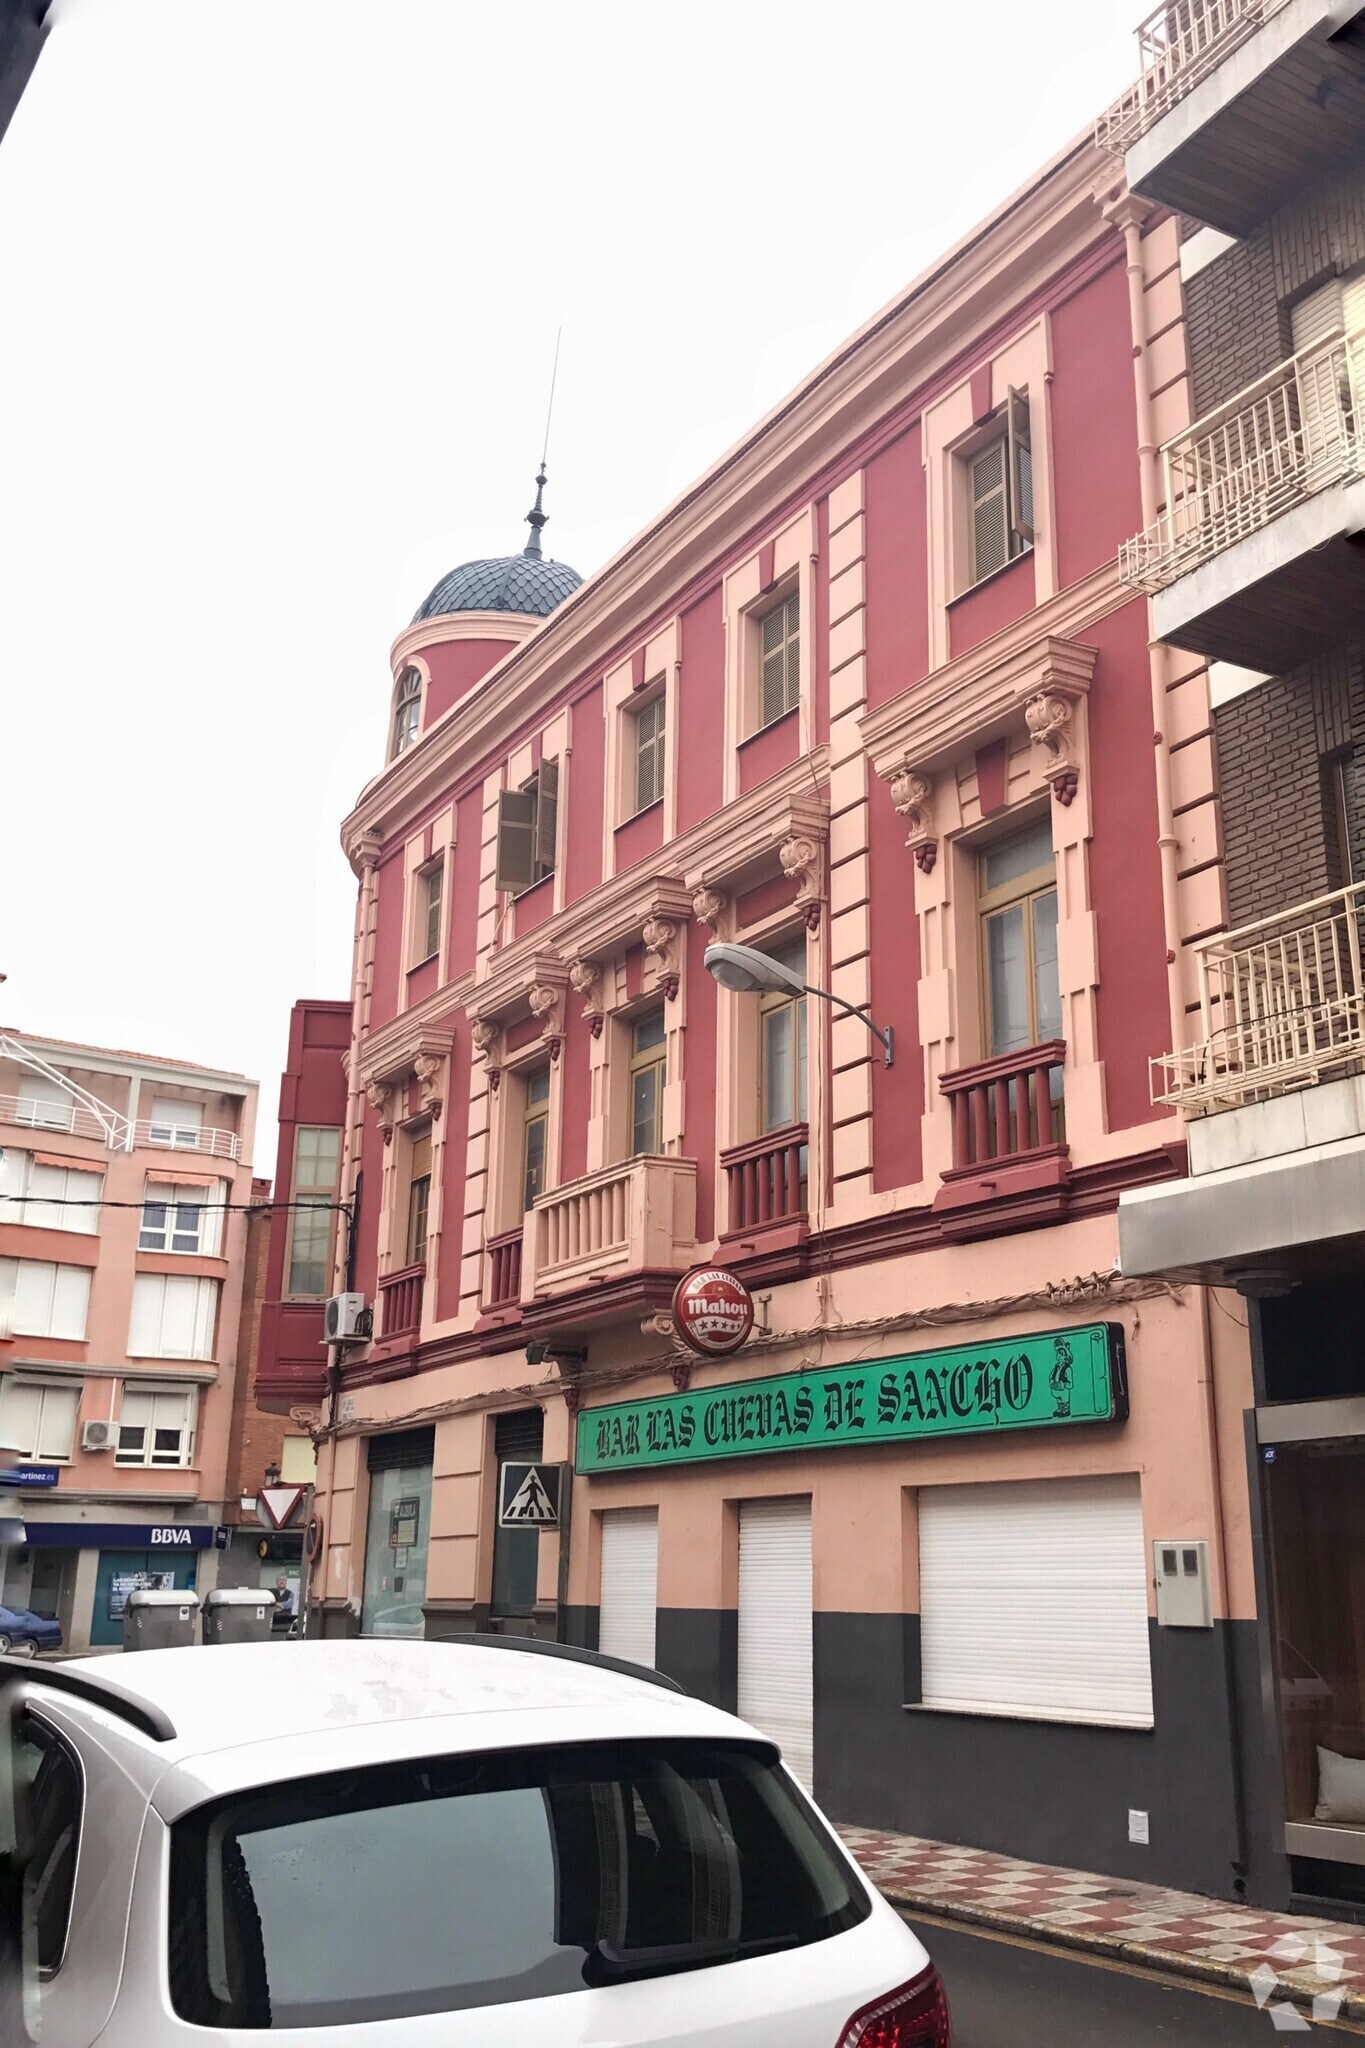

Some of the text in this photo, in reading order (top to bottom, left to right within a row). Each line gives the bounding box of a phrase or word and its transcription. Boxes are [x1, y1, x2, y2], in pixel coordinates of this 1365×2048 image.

[687, 1297, 748, 1316] Mahou
[596, 1353, 1033, 1460] BAR LAS CUEVAS DE SANCHO
[151, 1528, 192, 1544] BBVA
